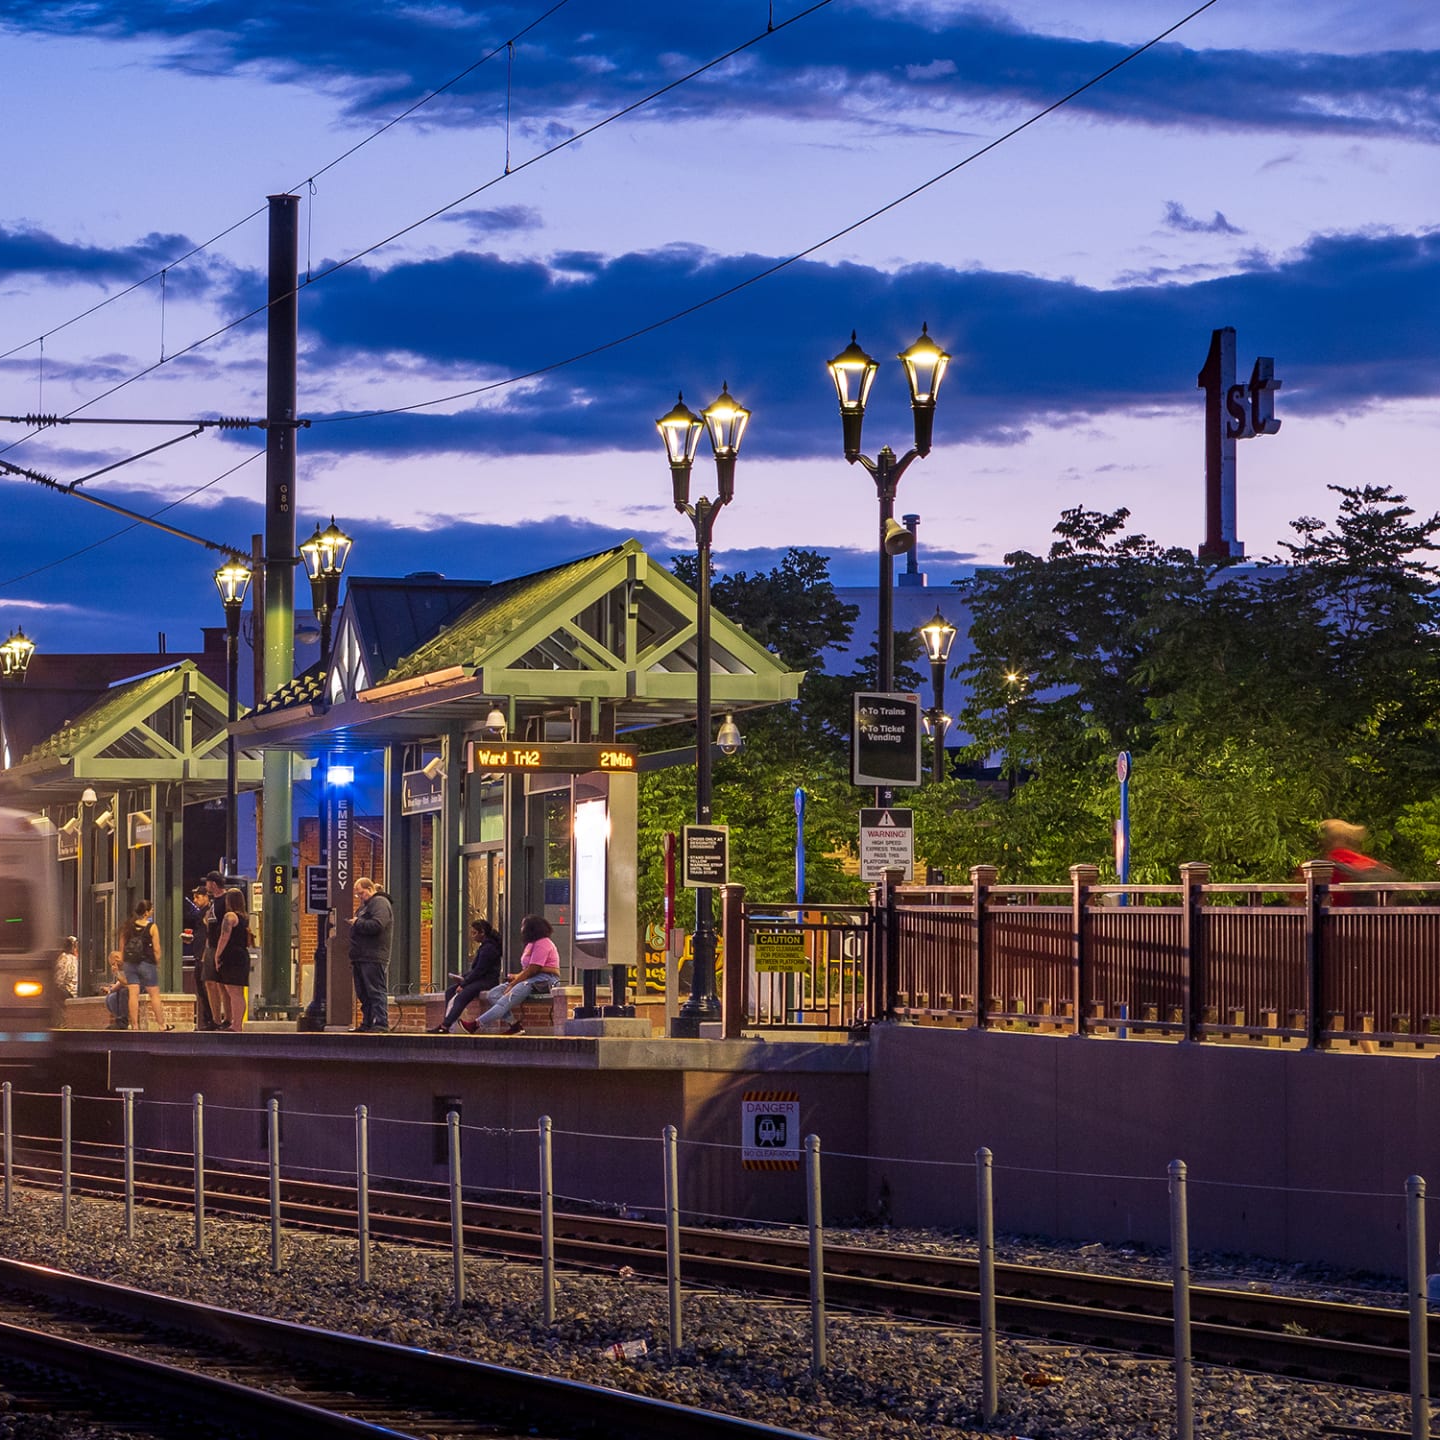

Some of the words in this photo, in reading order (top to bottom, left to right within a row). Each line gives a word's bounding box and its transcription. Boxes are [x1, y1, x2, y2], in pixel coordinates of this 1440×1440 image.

[868, 707, 879, 715] To
[880, 707, 906, 715] Trains
[868, 725, 879, 733] To
[880, 725, 905, 733] Ticket
[868, 733, 901, 743] Vending
[478, 750, 507, 765] Ward
[513, 751, 540, 765] Trk2
[868, 830, 907, 838] WARNING!
[338, 800, 348, 890] EMERGENCY
[275, 866, 283, 874] G
[276, 876, 282, 884] 8
[274, 886, 284, 894] 10
[746, 1103, 794, 1113] DANGER
